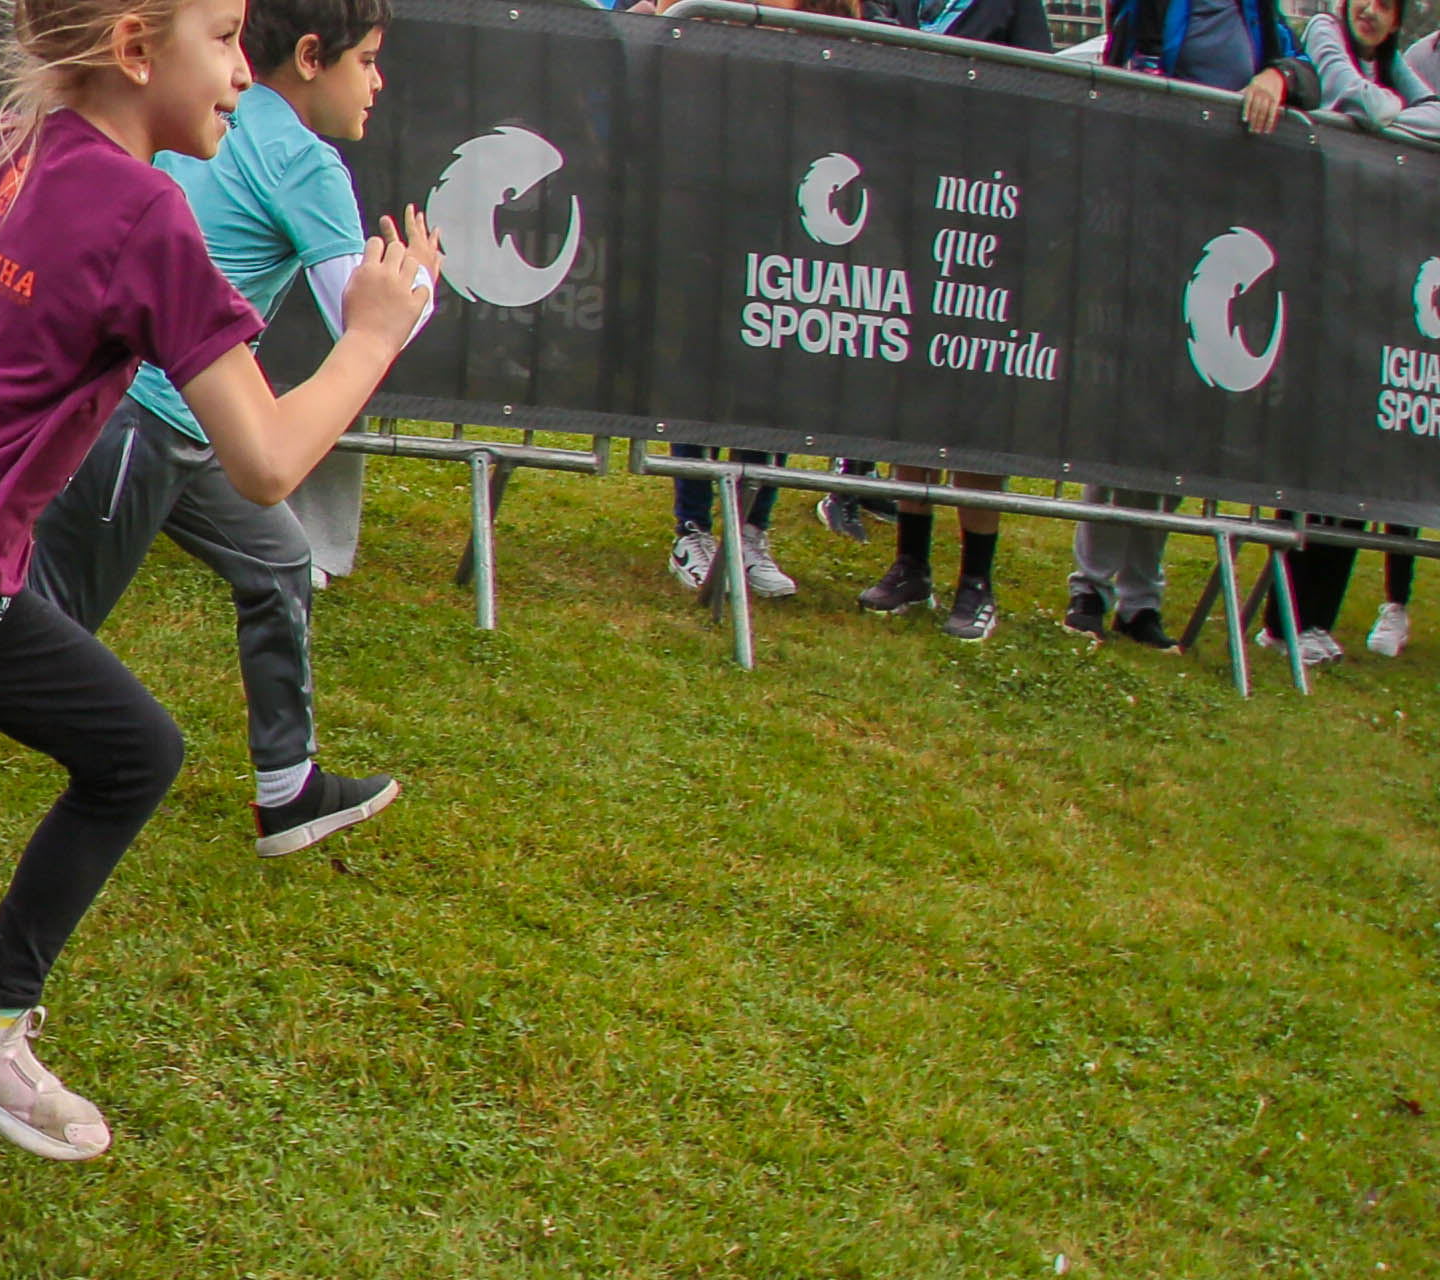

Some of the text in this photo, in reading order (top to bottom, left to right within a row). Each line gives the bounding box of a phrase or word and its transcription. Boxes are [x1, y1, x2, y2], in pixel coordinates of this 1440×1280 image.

[934, 169, 1021, 220] mais
[932, 227, 999, 278] que
[744, 252, 913, 315] IGUANA
[931, 279, 1011, 323] uma
[740, 301, 912, 363] SPORTS
[928, 328, 1060, 381] corrida
[1381, 345, 1440, 394] IGUA
[1377, 389, 1440, 438] SPOR
